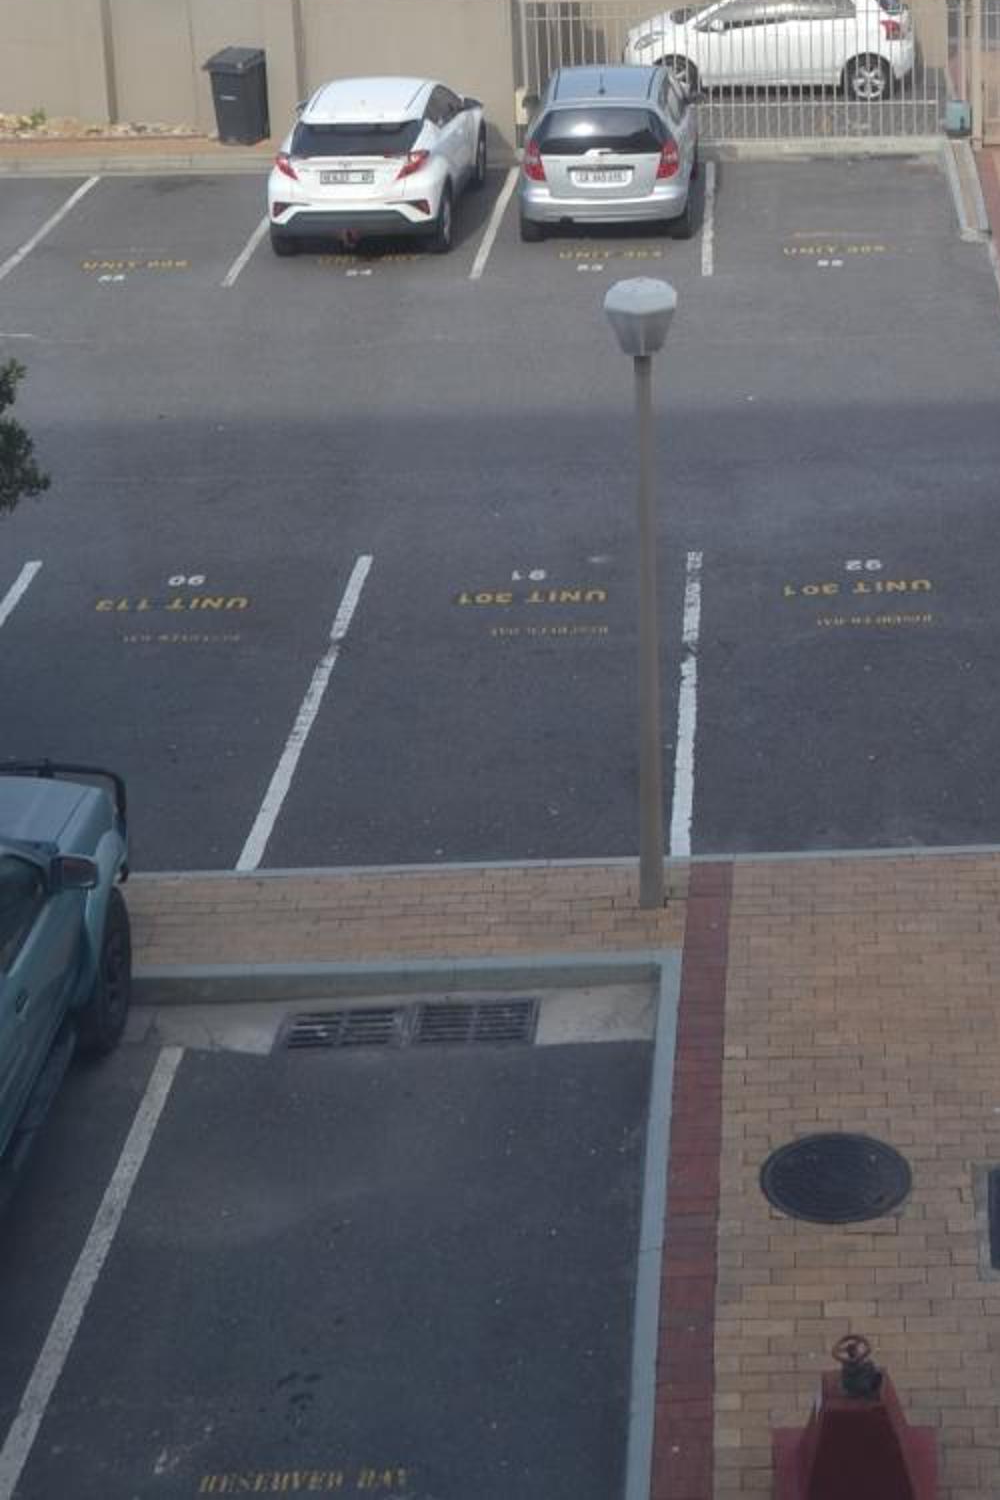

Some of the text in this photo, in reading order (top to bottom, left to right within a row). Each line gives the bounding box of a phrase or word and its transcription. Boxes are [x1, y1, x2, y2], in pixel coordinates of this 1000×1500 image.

[783, 579, 932, 597] UNIT 301
[95, 597, 249, 612] UNIT 113
[525, 591, 607, 605] UNIT
[199, 1473, 343, 1493] RESERVED
